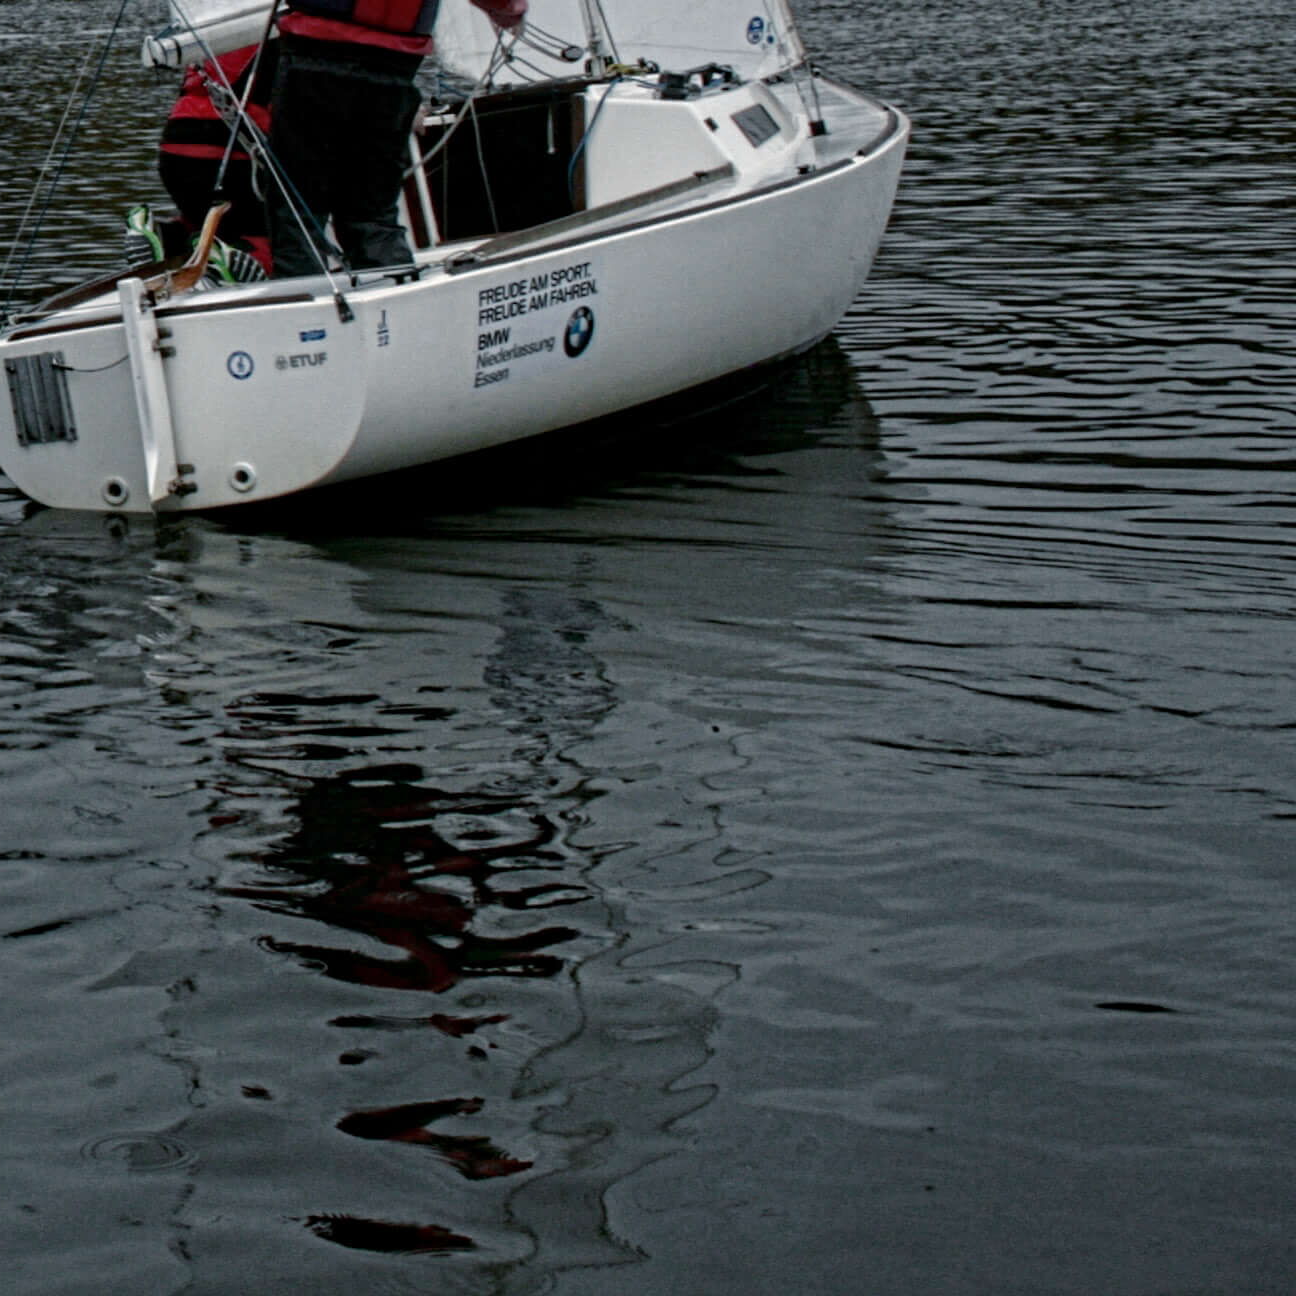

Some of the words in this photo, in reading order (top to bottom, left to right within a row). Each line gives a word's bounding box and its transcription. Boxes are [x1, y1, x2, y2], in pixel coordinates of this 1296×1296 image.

[478, 280, 528, 307] FREUDE
[529, 273, 549, 294] AM
[478, 299, 528, 327] FREUDE
[529, 292, 549, 311] AM
[477, 327, 511, 351] BMW
[477, 336, 556, 369] Niederlassung
[289, 352, 328, 368] ETUF
[473, 368, 510, 389] Essen
